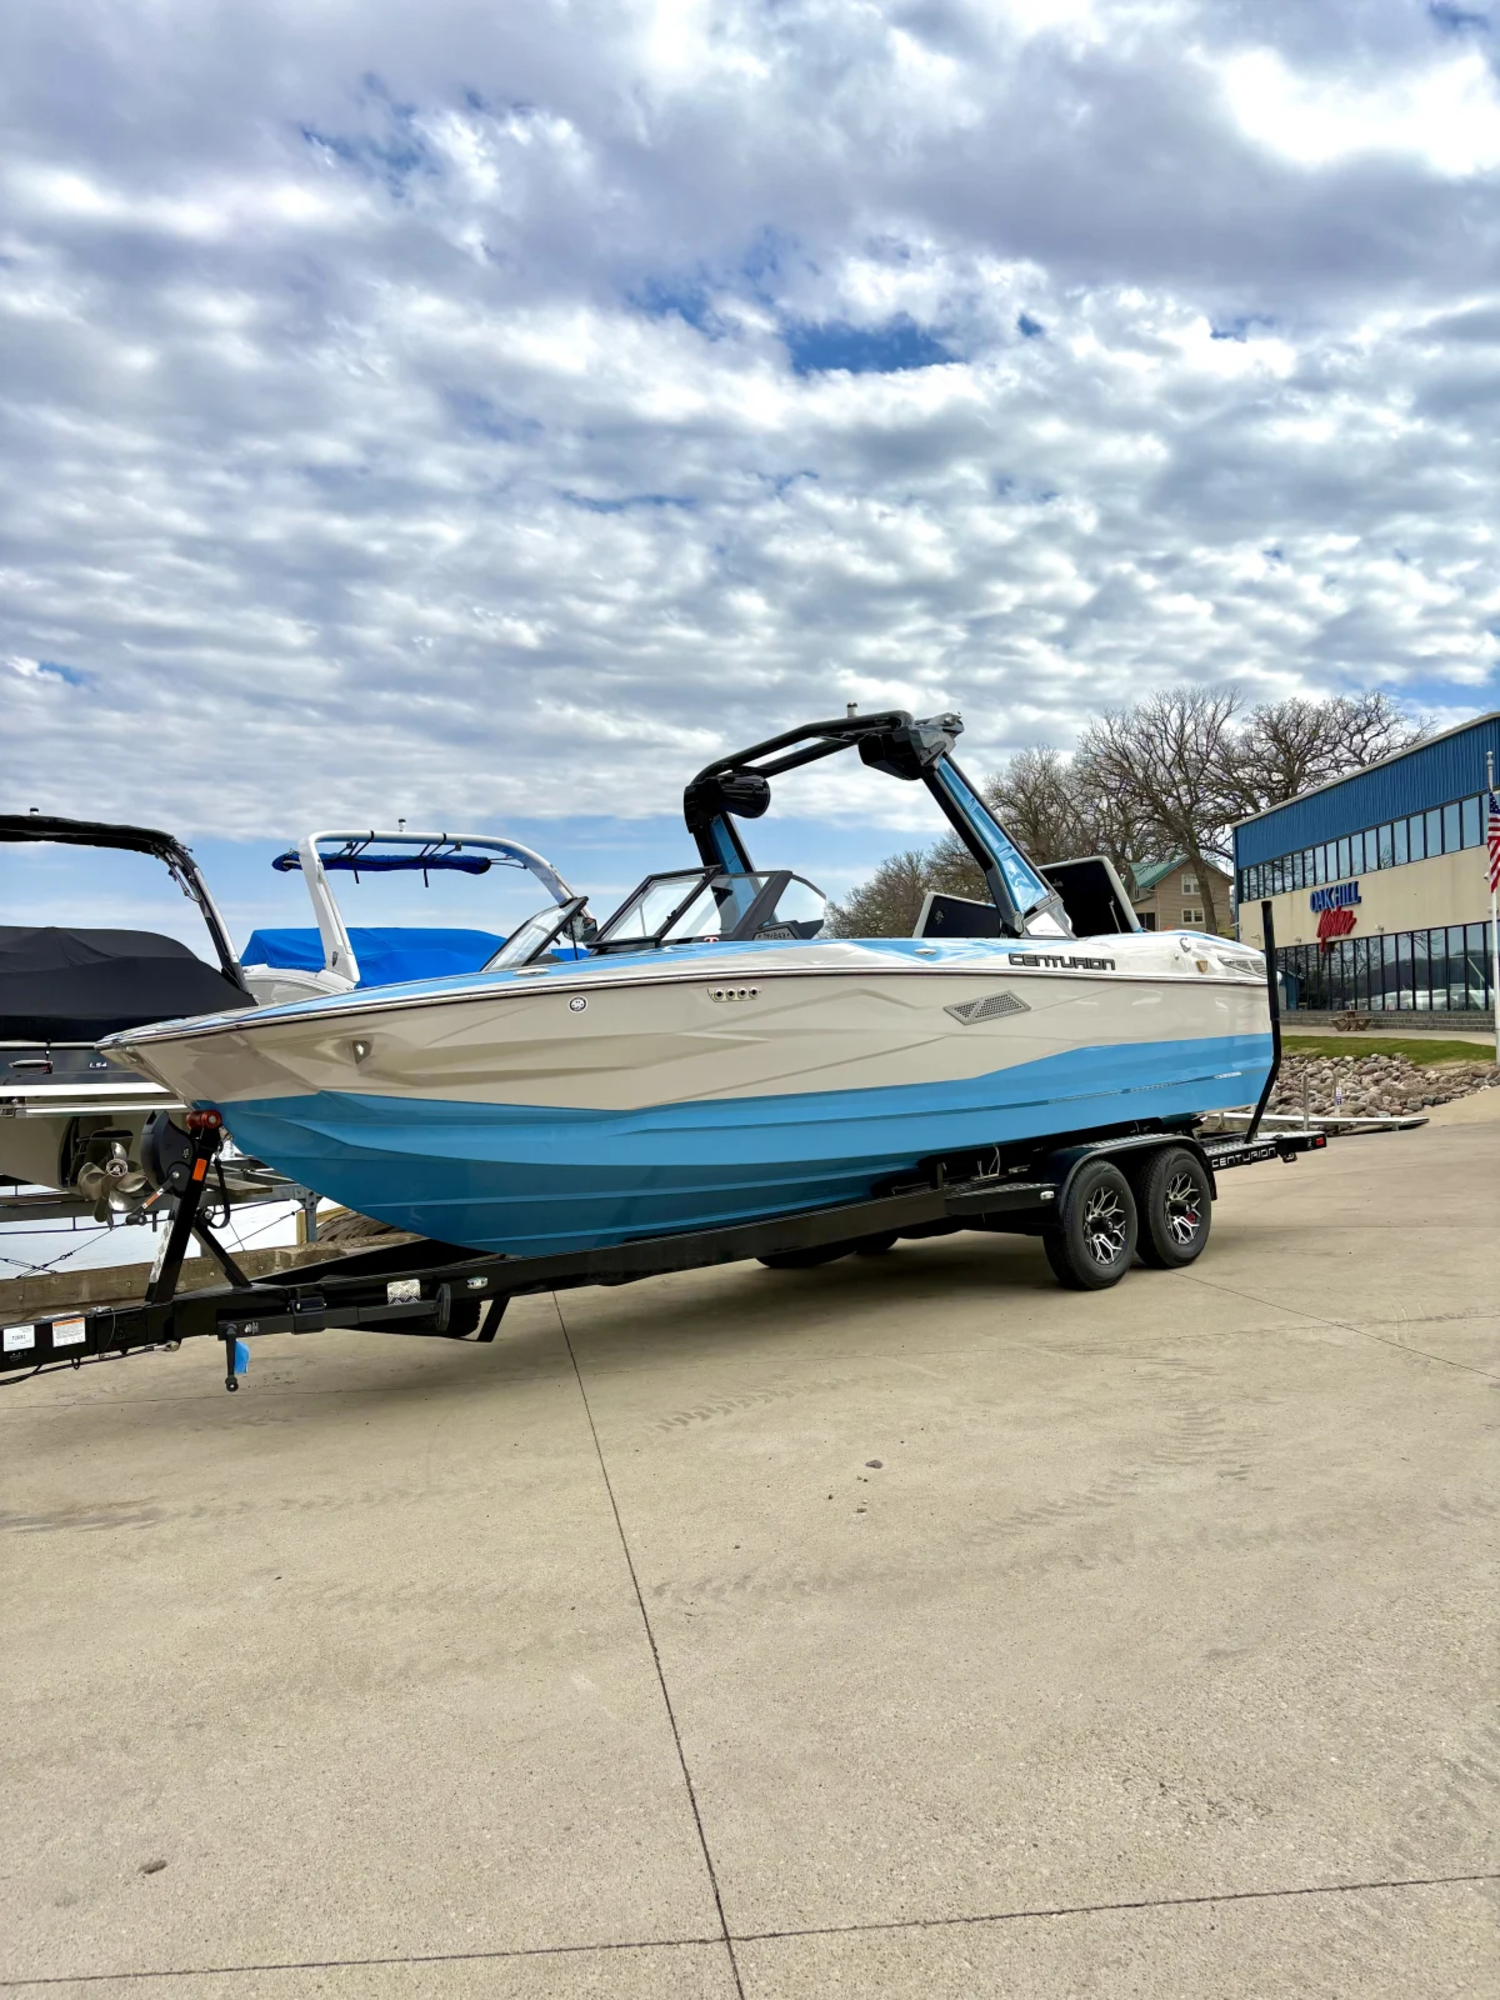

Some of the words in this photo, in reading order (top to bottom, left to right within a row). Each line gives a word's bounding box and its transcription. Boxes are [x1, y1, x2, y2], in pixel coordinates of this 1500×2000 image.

[1310, 886, 1335, 913] OAK
[1334, 881, 1362, 907] HILL
[1008, 953, 1116, 971] CENTURION
[1211, 1147, 1276, 1168] CENTURION
